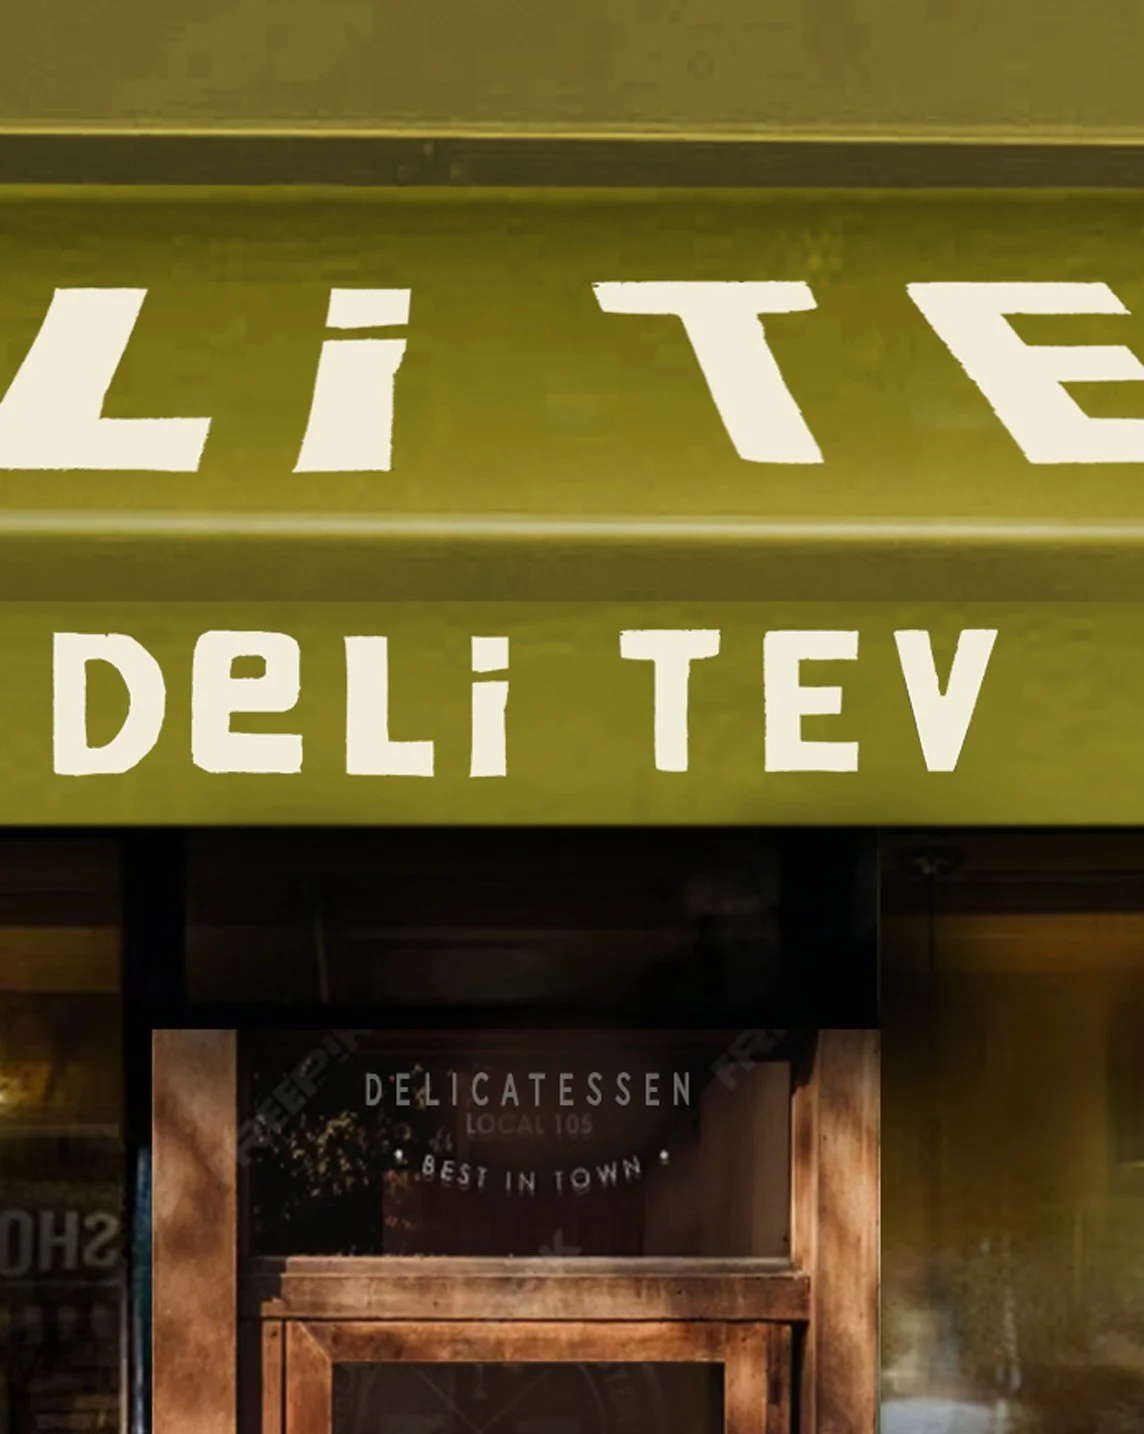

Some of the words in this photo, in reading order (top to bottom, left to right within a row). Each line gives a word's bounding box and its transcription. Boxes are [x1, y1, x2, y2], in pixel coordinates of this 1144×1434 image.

[620, 629, 997, 773] TEV
[364, 1071, 691, 1107] DELICATESSEN
[466, 1113, 546, 1136] LOCAL
[556, 1113, 593, 1136] 105
[421, 1154, 488, 1189] BEST
[505, 1170, 536, 1194] IN
[554, 1154, 643, 1194] TOWN
